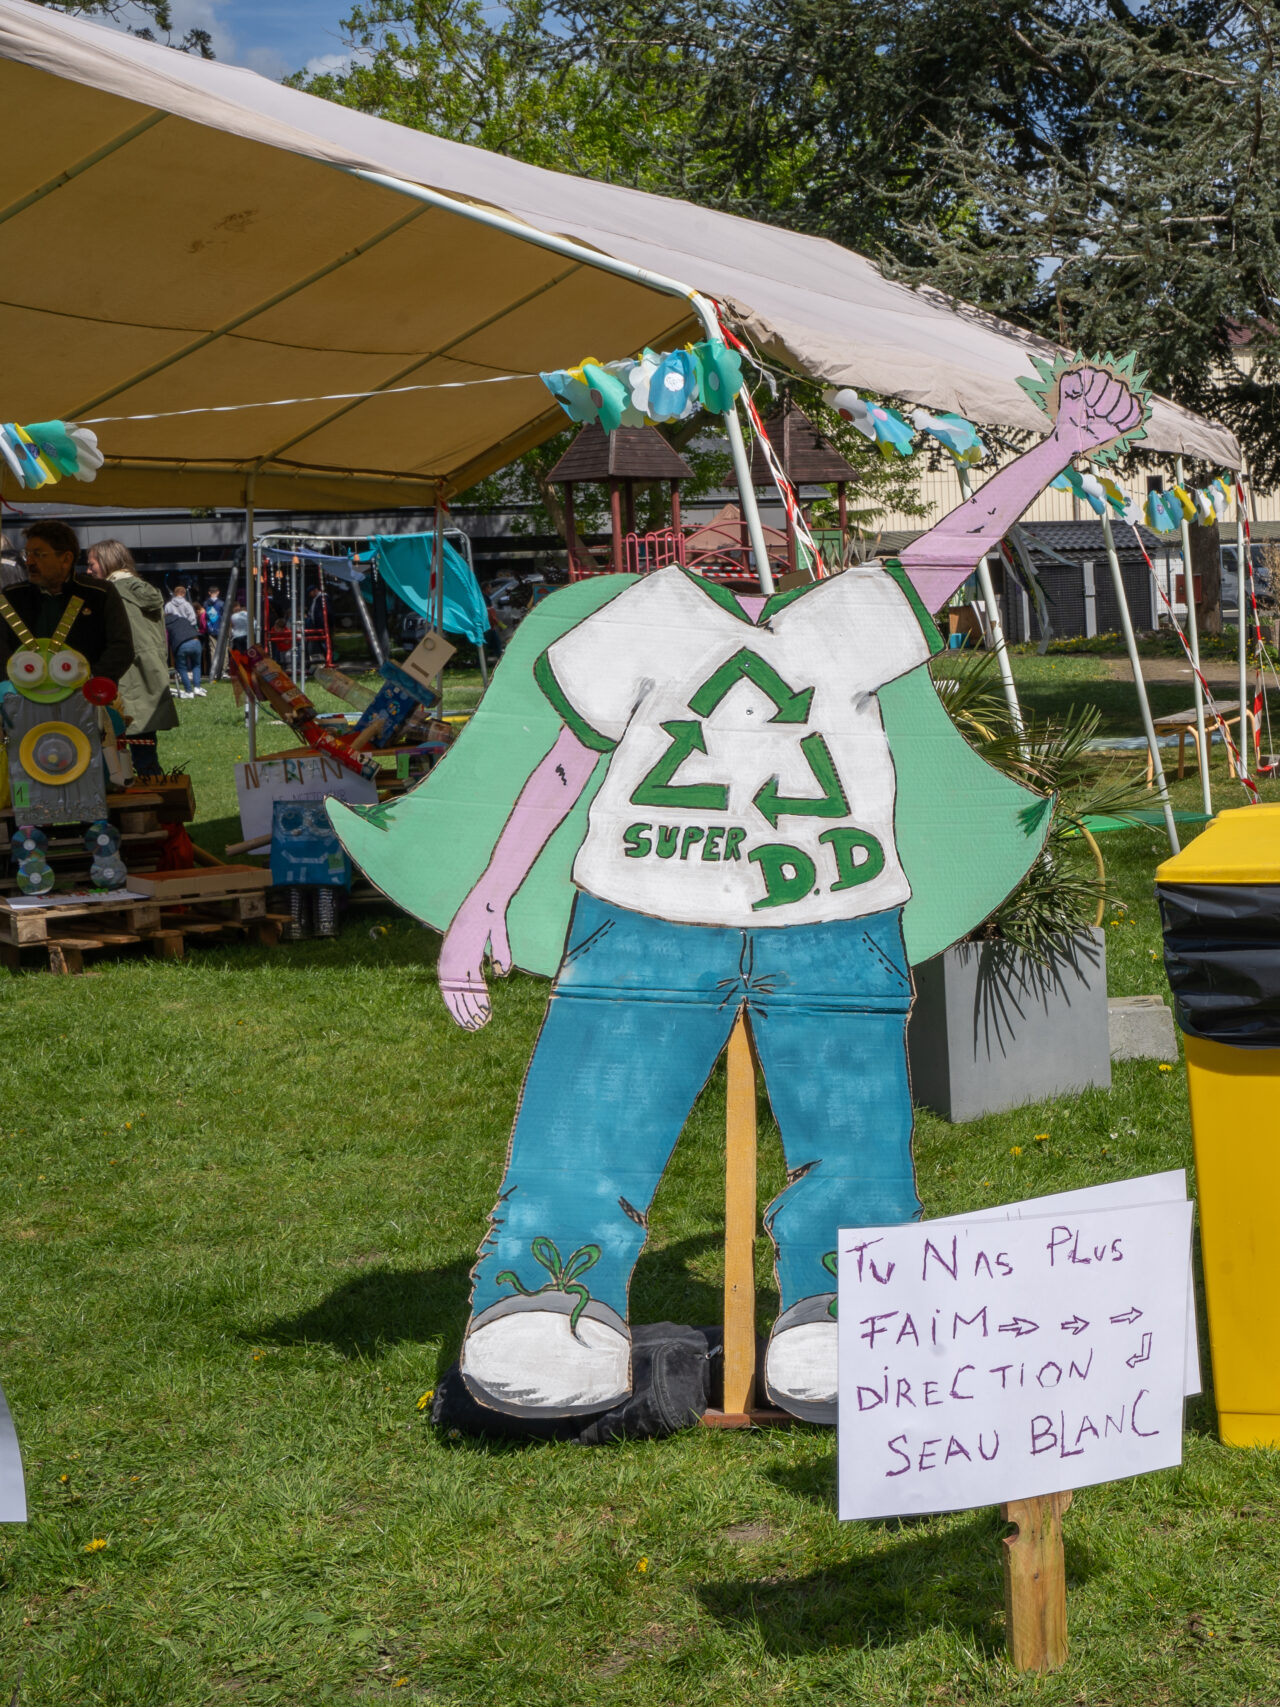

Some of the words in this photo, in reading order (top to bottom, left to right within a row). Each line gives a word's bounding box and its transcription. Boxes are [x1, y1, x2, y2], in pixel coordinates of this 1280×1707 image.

[623, 823, 747, 861] SUPER
[885, 1430, 1000, 1477] SEAU
[1030, 1390, 1159, 1459] BLANC
